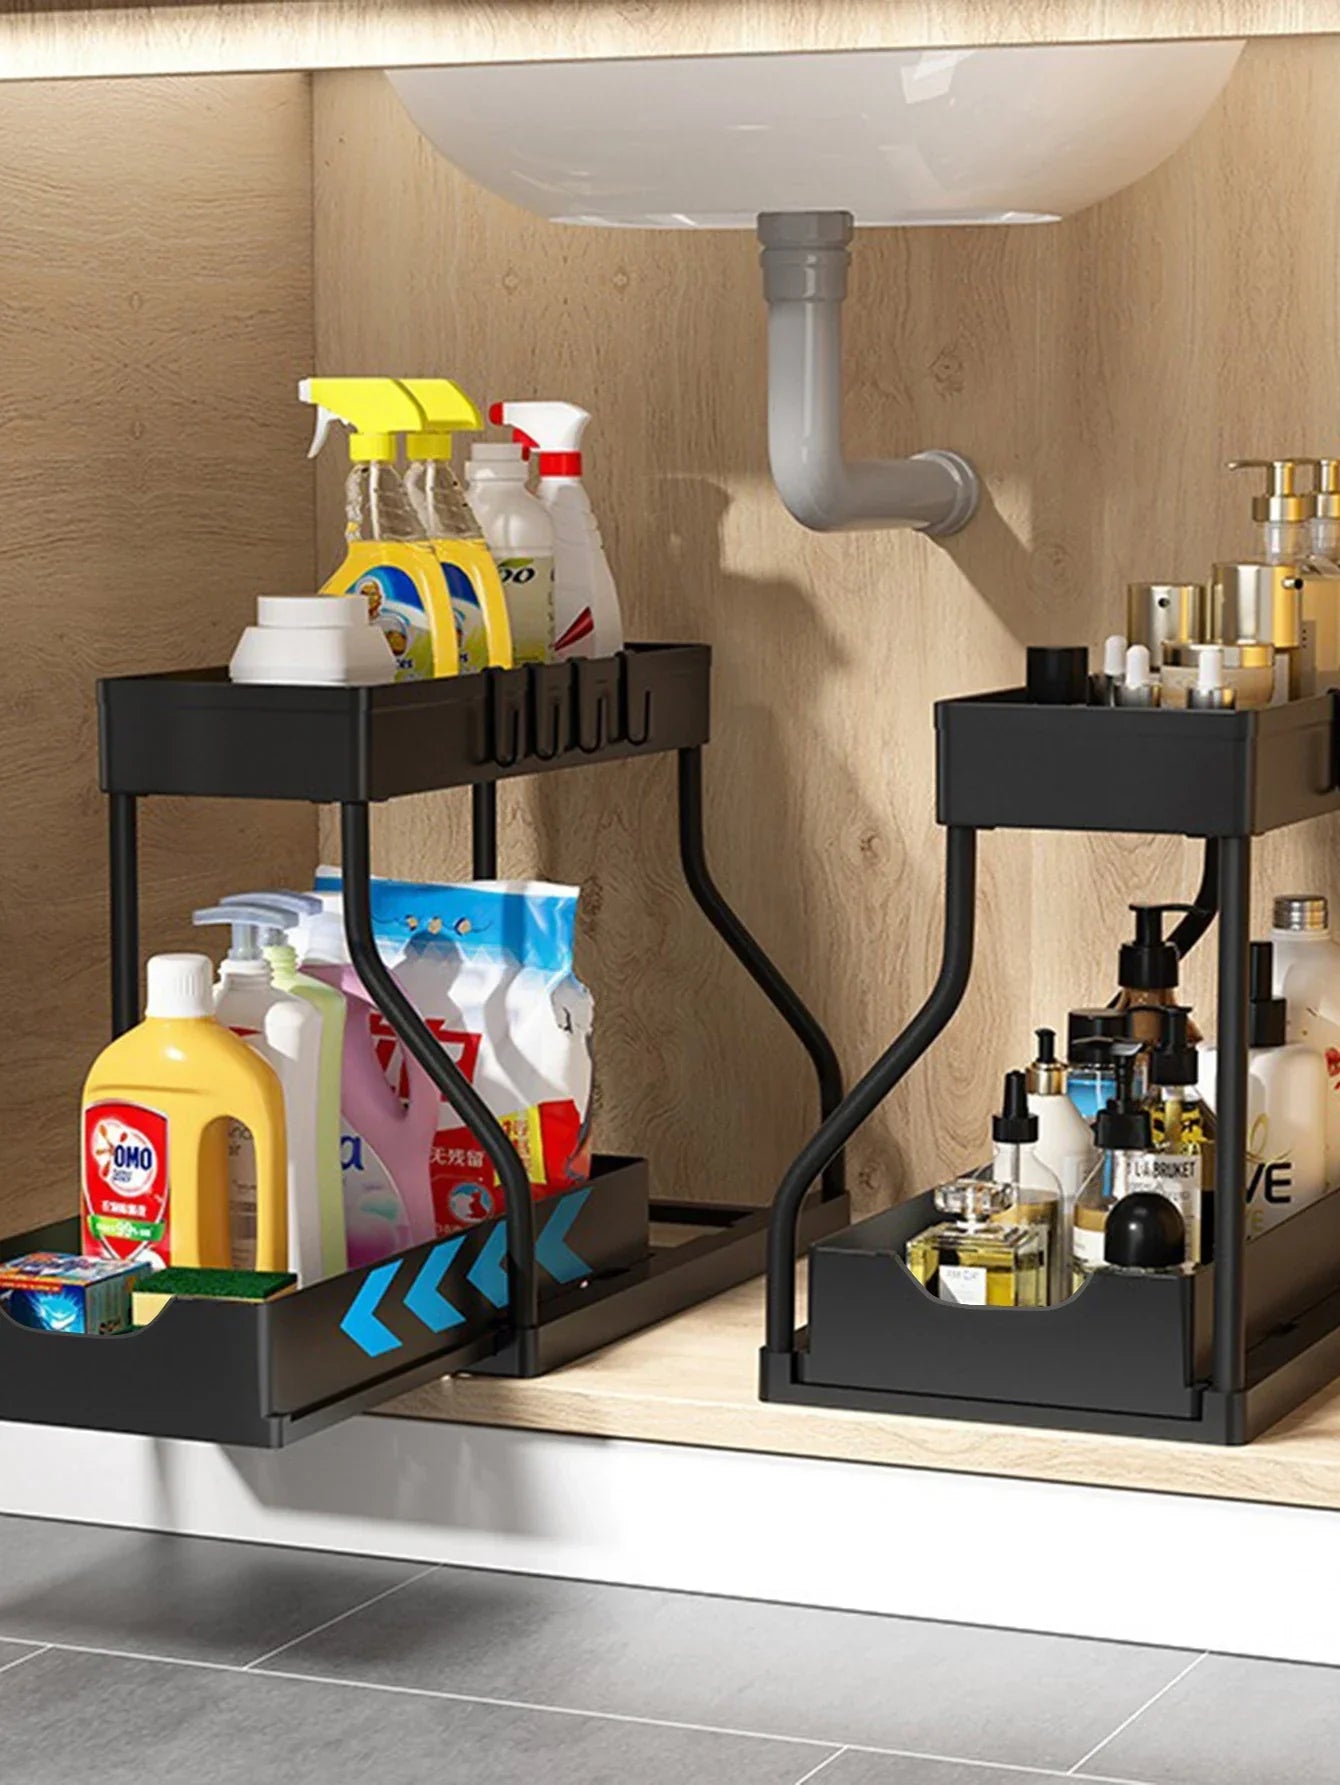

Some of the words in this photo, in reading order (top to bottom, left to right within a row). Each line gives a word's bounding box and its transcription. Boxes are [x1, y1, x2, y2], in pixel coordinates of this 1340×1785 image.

[114, 1144, 152, 1171] OMO
[430, 1147, 483, 1168] 无残留
